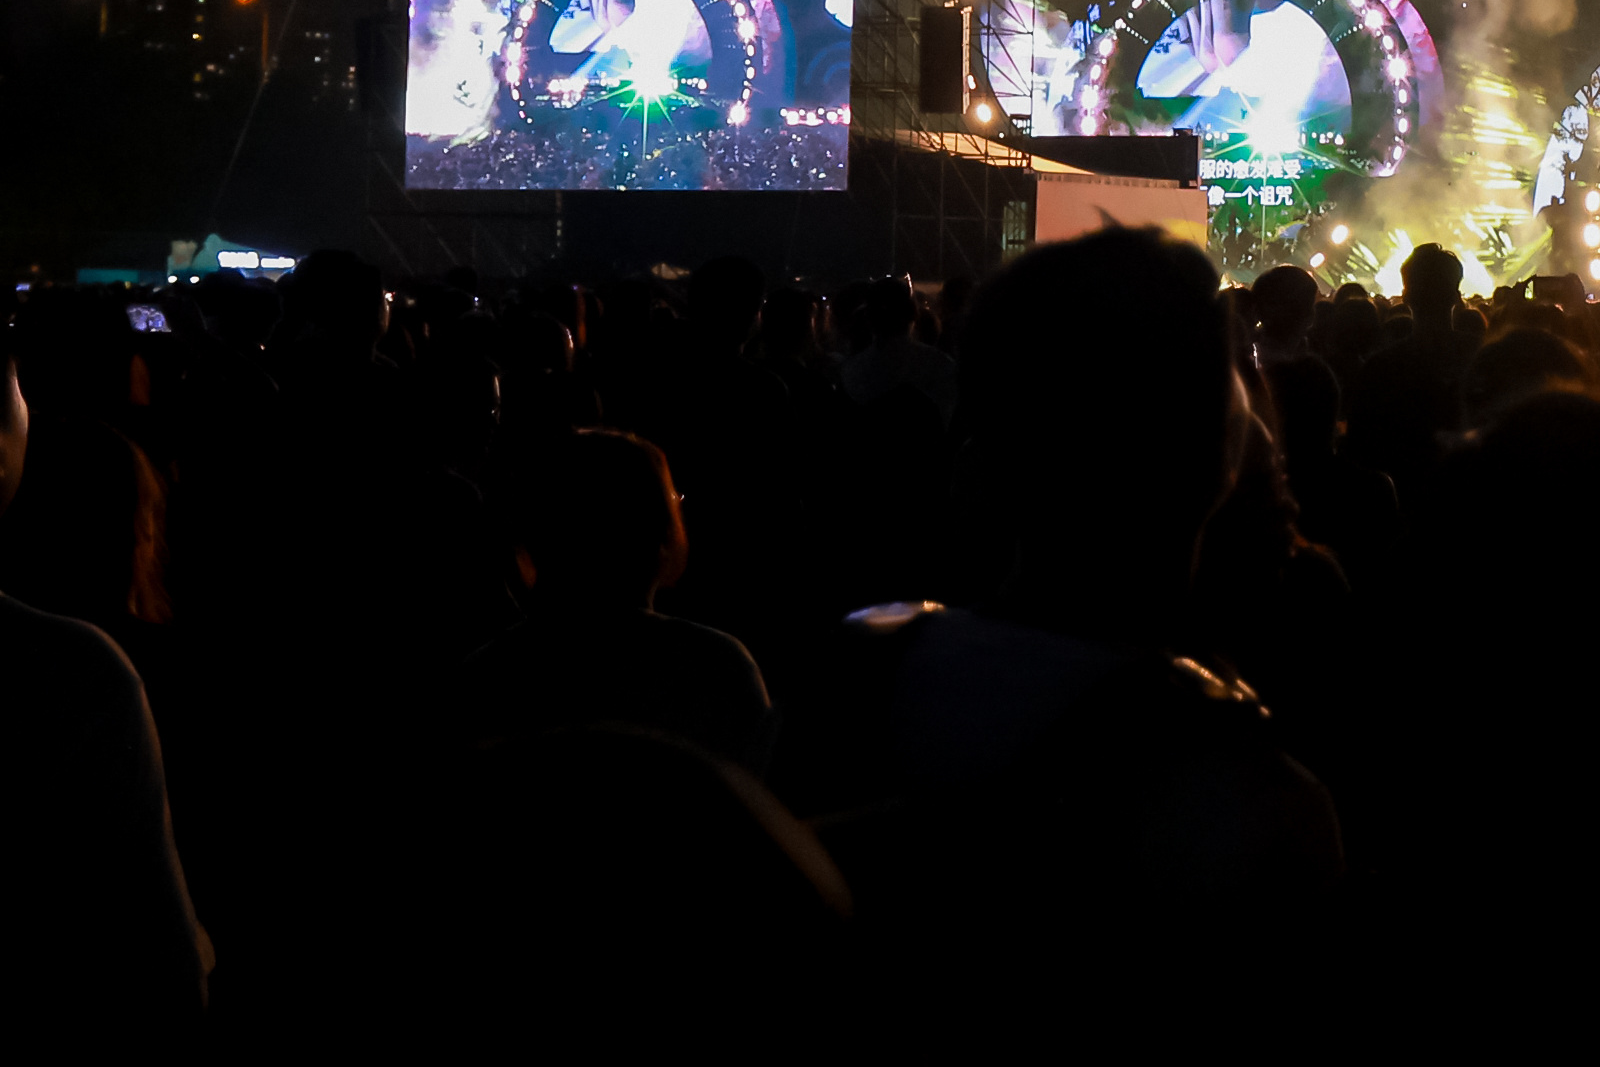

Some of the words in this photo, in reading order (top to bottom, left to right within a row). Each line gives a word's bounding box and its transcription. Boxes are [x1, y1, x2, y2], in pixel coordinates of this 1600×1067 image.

[1199, 184, 1294, 206] 像一个诅咒
